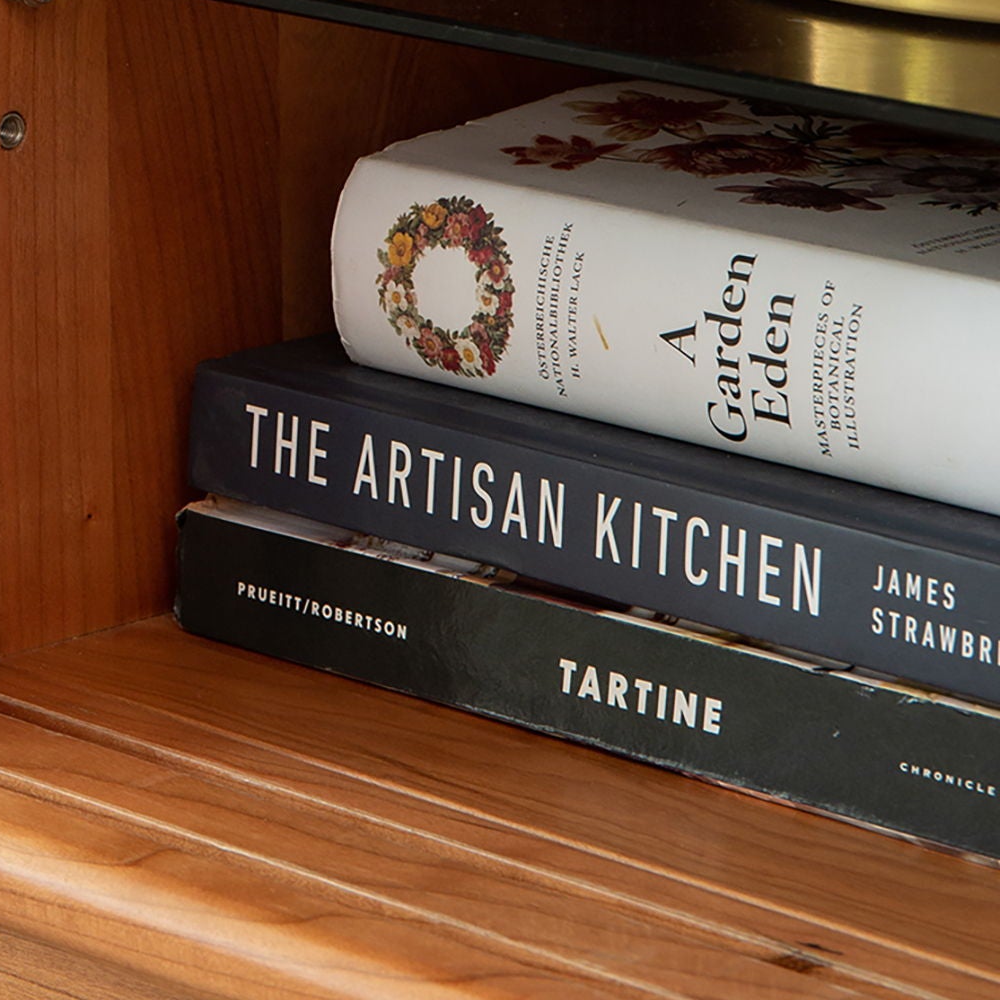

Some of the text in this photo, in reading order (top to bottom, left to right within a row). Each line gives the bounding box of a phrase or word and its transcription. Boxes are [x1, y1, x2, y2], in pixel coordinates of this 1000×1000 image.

[549, 222, 574, 398] NATIONALBIBLIOTHEK
[570, 251, 585, 292] LACK
[568, 296, 578, 358] WALTER
[659, 320, 698, 367] A
[704, 252, 759, 443] Garden
[748, 293, 797, 429] Eden
[813, 280, 836, 458] MASTERPIECES OF
[828, 316, 845, 431] BOTANICAL
[843, 303, 864, 450] ILLUSTRATION
[245, 403, 823, 617] THE ARTISAN KITCHEN
[237, 581, 408, 640] PRUEITT/ROBERTSON
[872, 564, 956, 610] JAMES
[558, 658, 723, 735] TARTINE
[899, 761, 997, 797] CHRONICLE
